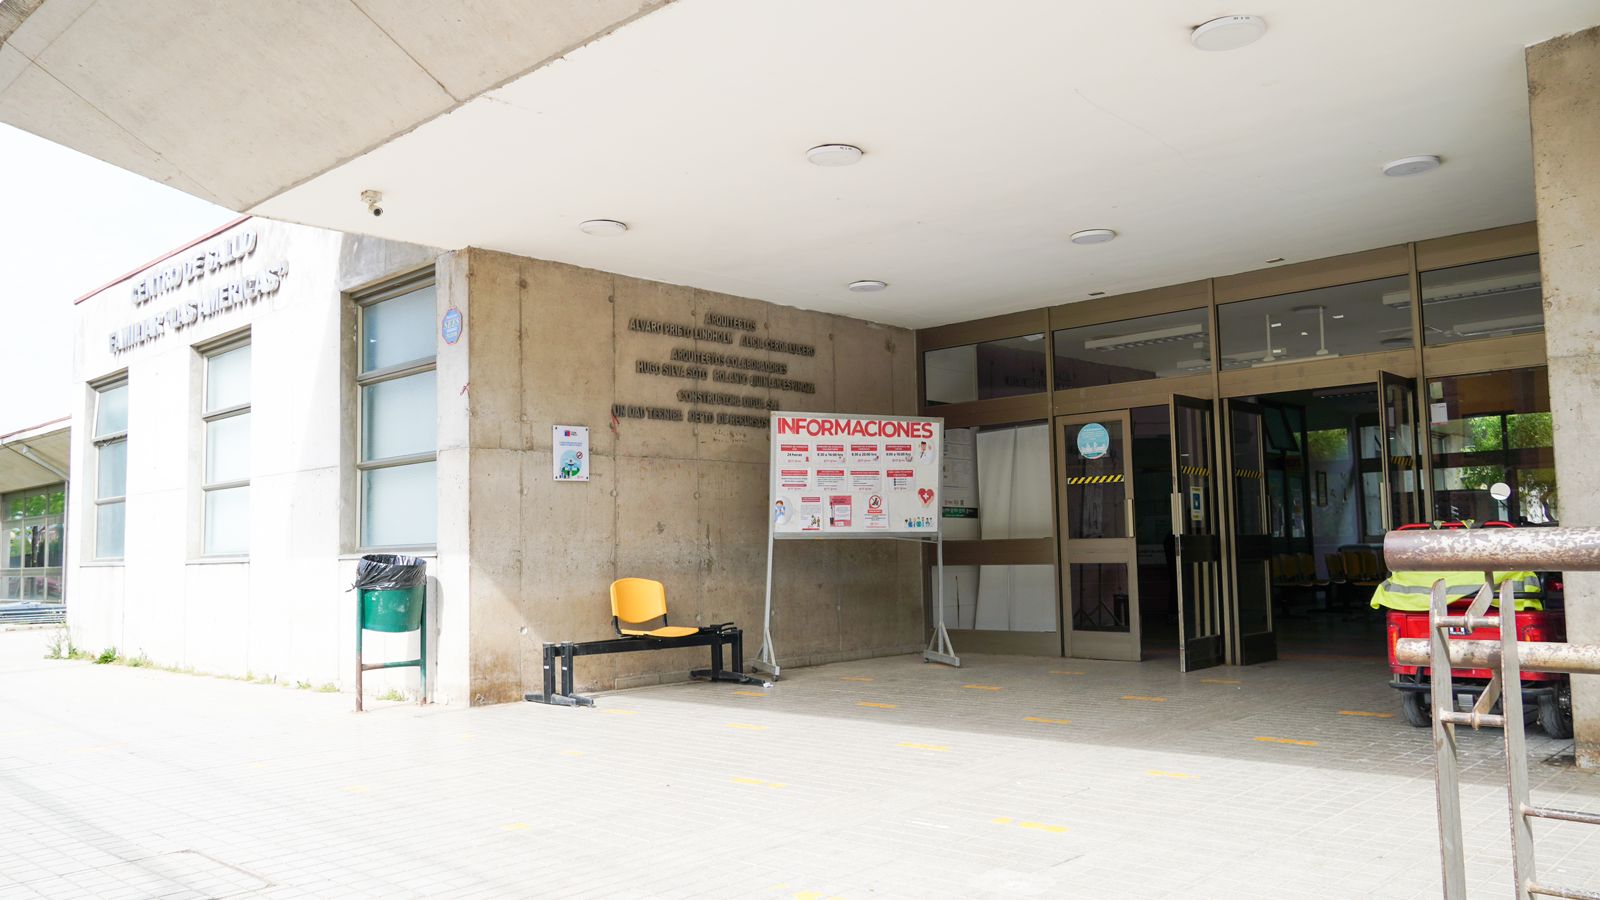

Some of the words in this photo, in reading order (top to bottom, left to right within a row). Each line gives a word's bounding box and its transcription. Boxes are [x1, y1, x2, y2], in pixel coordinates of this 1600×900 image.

[132, 262, 183, 307] CENTRO
[183, 250, 206, 284] DE
[207, 229, 258, 273] SALUD
[629, 319, 662, 333] ALVARO
[663, 323, 693, 338] PRIETO
[694, 328, 733, 344] LINDHOLM
[706, 313, 756, 331] ARQUITECTOS
[109, 312, 164, 355] FAMILIAR
[671, 348, 724, 365] ARQUITECTOS
[636, 360, 661, 375] HUGO
[662, 363, 685, 378] SILVA
[686, 366, 708, 380] SOTO
[777, 417, 933, 439] INFORMACIONES
